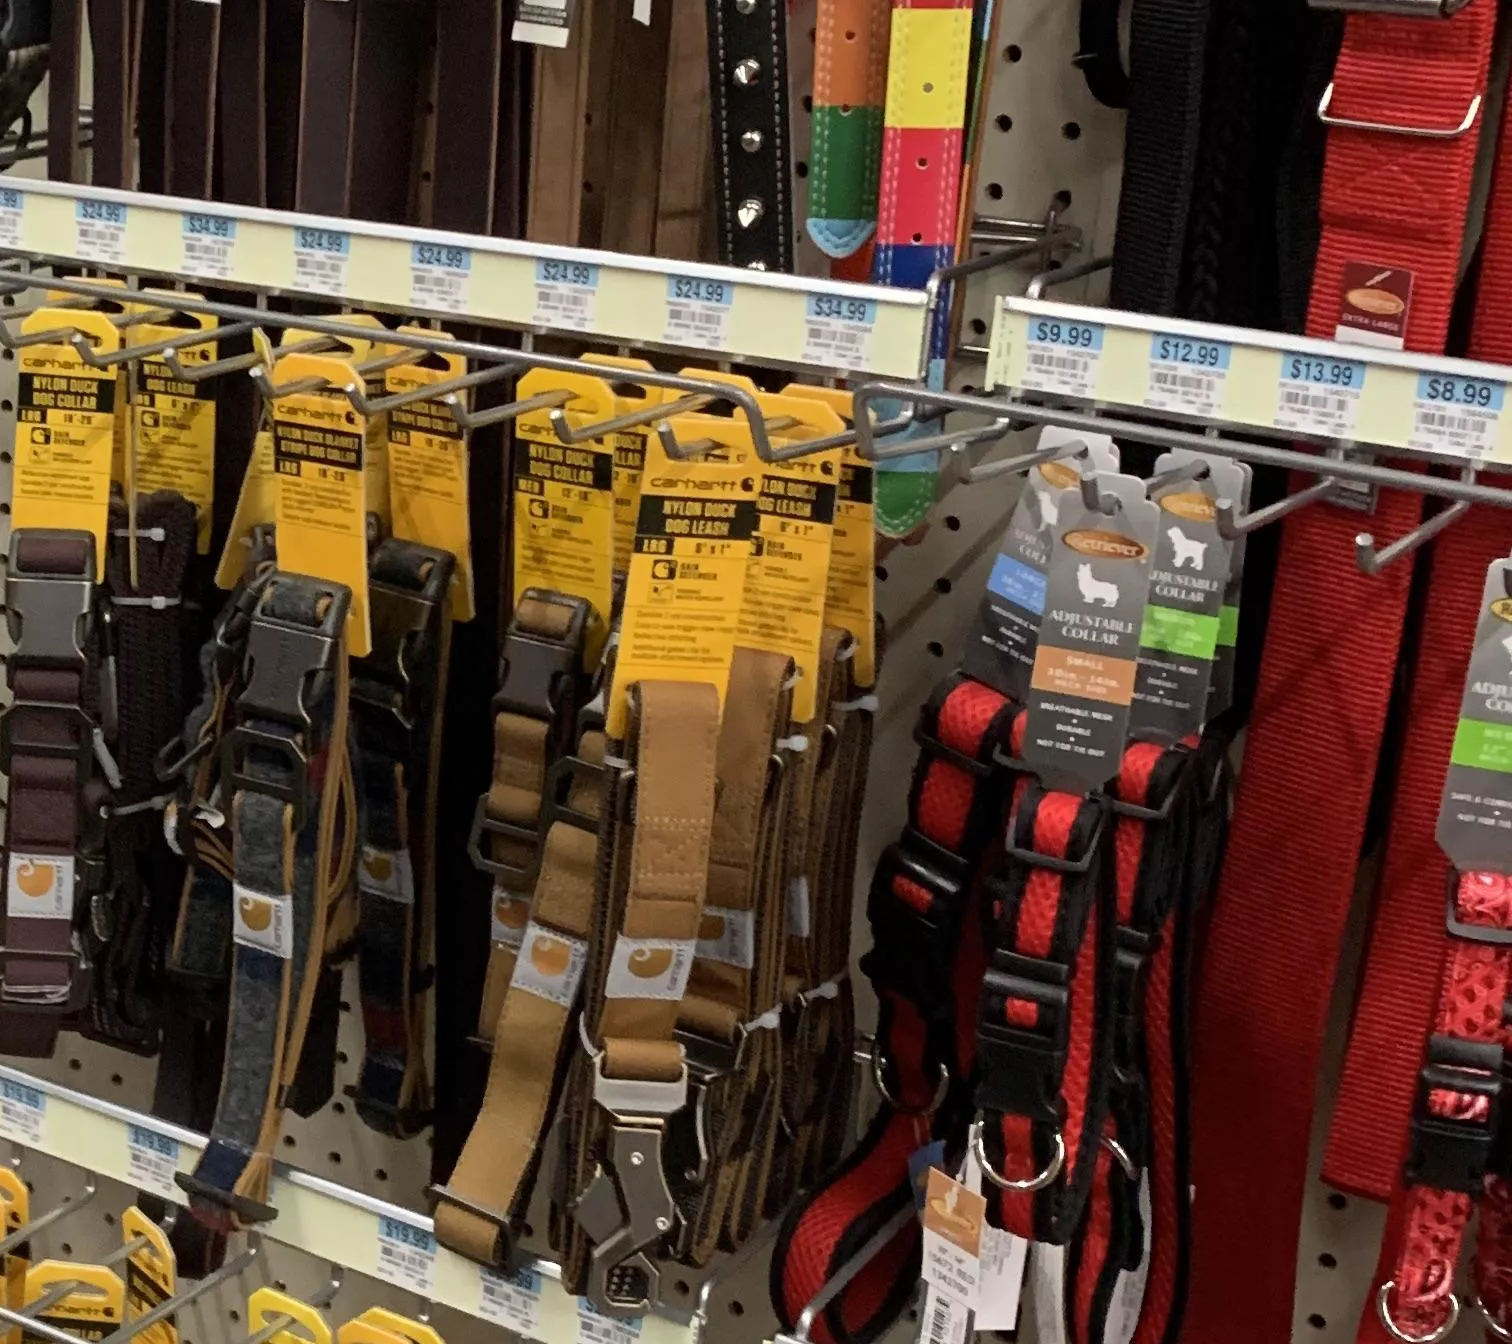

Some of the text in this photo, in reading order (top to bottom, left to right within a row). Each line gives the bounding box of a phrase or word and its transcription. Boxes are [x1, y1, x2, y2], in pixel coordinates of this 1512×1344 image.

[81, 200, 121, 223] $24.99
[188, 214, 229, 238] $34.99
[300, 230, 344, 254] $24.99
[417, 244, 465, 269] $24.99
[543, 262, 590, 285] $24.99
[674, 278, 725, 303] $24.99
[814, 296, 867, 323] $34.99
[1340, 313, 1400, 333] EXTRA LARGE
[1036, 321, 1093, 348] $9.99
[1159, 339, 1220, 368] $12.99
[1289, 357, 1354, 387] $13.99
[32, 375, 99, 395] NYLON DUCK
[1426, 377, 1492, 408] $8.99
[32, 391, 98, 410] DOG COLLAR
[277, 404, 343, 423] carhartt
[528, 443, 595, 469] NYLON DUCK
[529, 461, 594, 486] DOG COLLAR
[650, 476, 738, 493] carhartt
[787, 482, 818, 501] DUCK
[662, 500, 737, 518] NYLON DUCK
[776, 498, 812, 518] LEASH
[665, 518, 731, 536] DOG LEASH
[642, 539, 668, 554] LRG
[1066, 532, 1140, 557] Retriever
[1154, 582, 1206, 604] COLLAR
[1048, 609, 1136, 634] ADJUSTABLE
[1061, 624, 1120, 646] COLLAR
[1066, 655, 1105, 671] SMALL
[1040, 701, 1114, 722] BREATHABLE MESH
[1055, 721, 1092, 737] DURABLE
[1036, 736, 1106, 758] NOT FOR TIE OUT
[386, 1218, 430, 1250] $19.99
